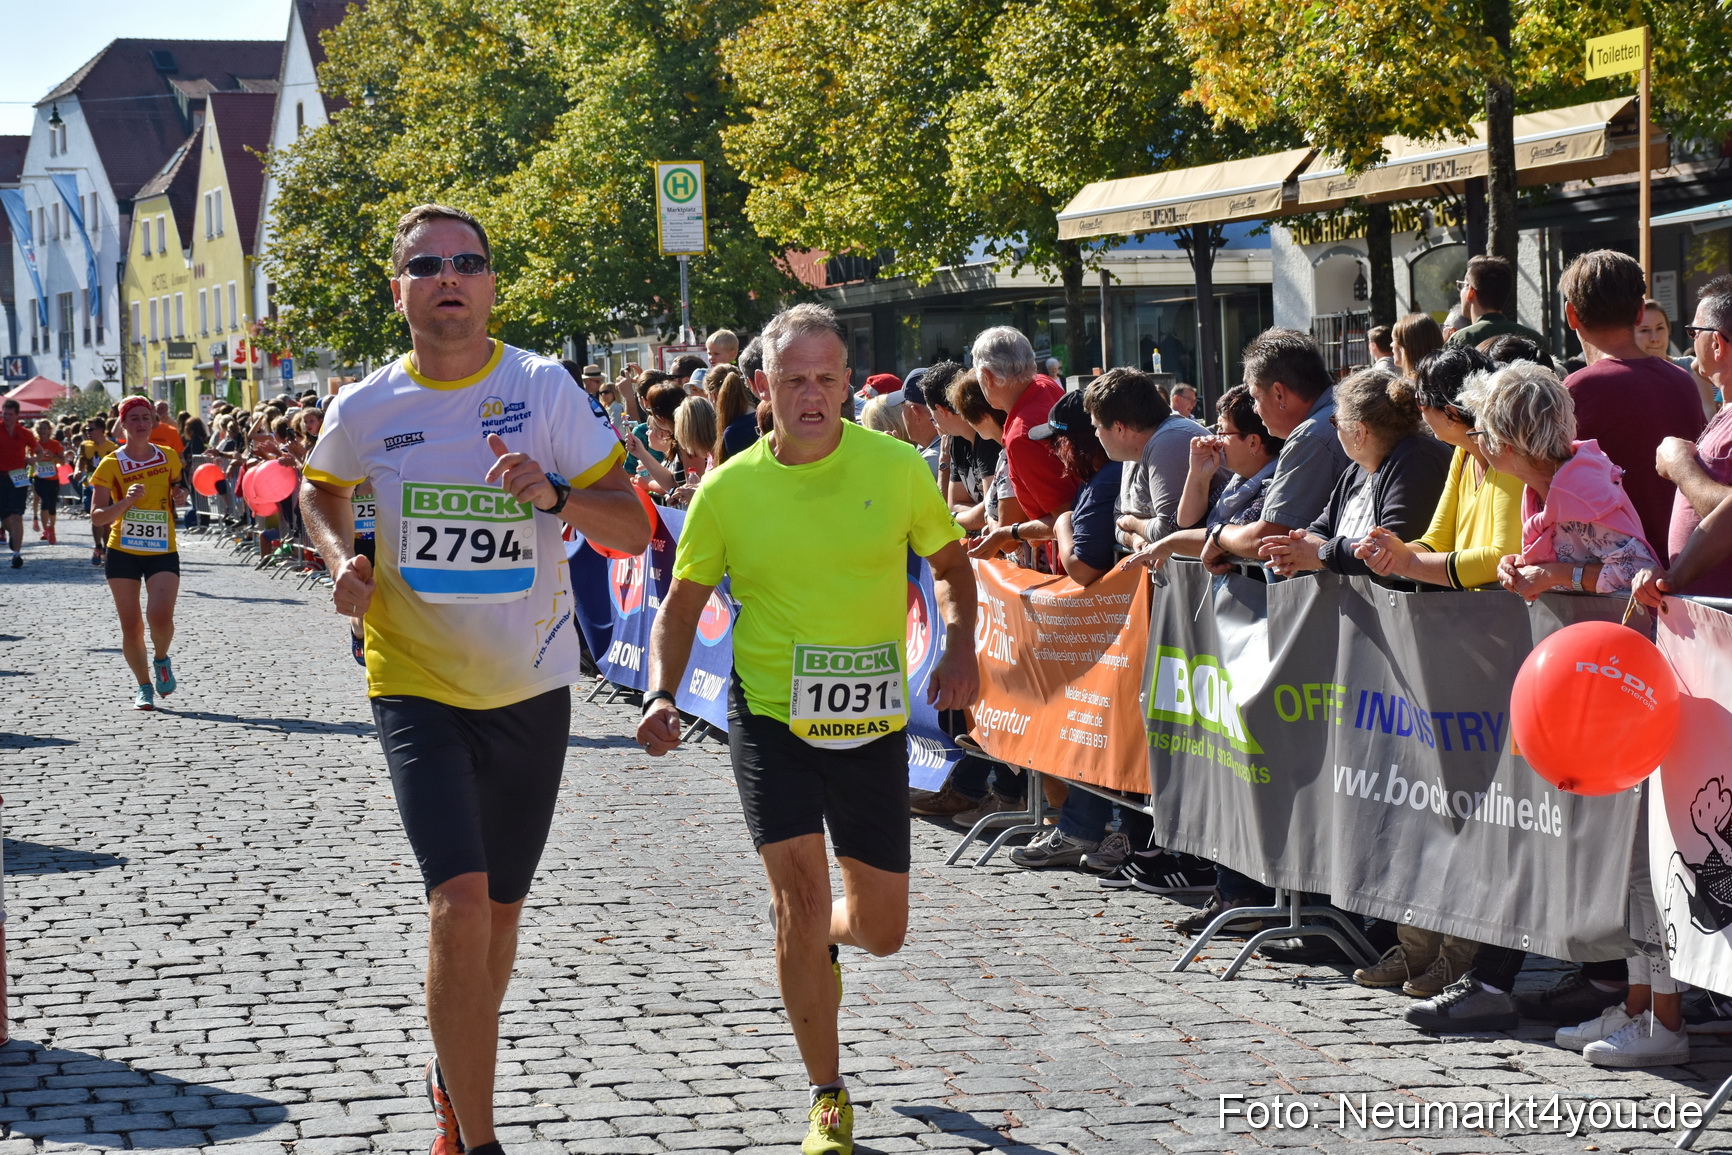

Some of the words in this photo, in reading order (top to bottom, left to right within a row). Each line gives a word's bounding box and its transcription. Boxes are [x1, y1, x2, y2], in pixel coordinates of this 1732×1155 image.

[1597, 44, 1641, 66] Toiletten
[671, 176, 689, 195] H
[283, 361, 291, 378] P
[482, 401, 503, 418] 20
[481, 411, 531, 428] Neumarkter
[384, 431, 424, 448] BOCK
[123, 473, 145, 484] MAX
[147, 466, 169, 477] BÖGL
[412, 489, 525, 518] BOCK
[126, 512, 165, 522] BOCK
[126, 523, 162, 538] 2381
[415, 525, 521, 564] 2794
[1057, 594, 1095, 608] moderner
[1095, 593, 1131, 606] Partner
[1042, 611, 1082, 629] Konzeption
[1083, 612, 1100, 625] und
[1053, 631, 1088, 647] Projekte
[1089, 634, 1105, 643] was
[533, 646, 548, 669] 14./15.
[804, 648, 893, 673] BOCK
[1079, 648, 1093, 662] und
[807, 681, 889, 713] 1031
[1620, 685, 1655, 711] energie
[975, 699, 1031, 737] Agentur
[1354, 689, 1504, 753] INDUSTRY
[807, 720, 890, 737] ANDREAS
[1093, 733, 1108, 749] 897
[1145, 724, 1205, 756] inspired
[1206, 737, 1215, 766] by
